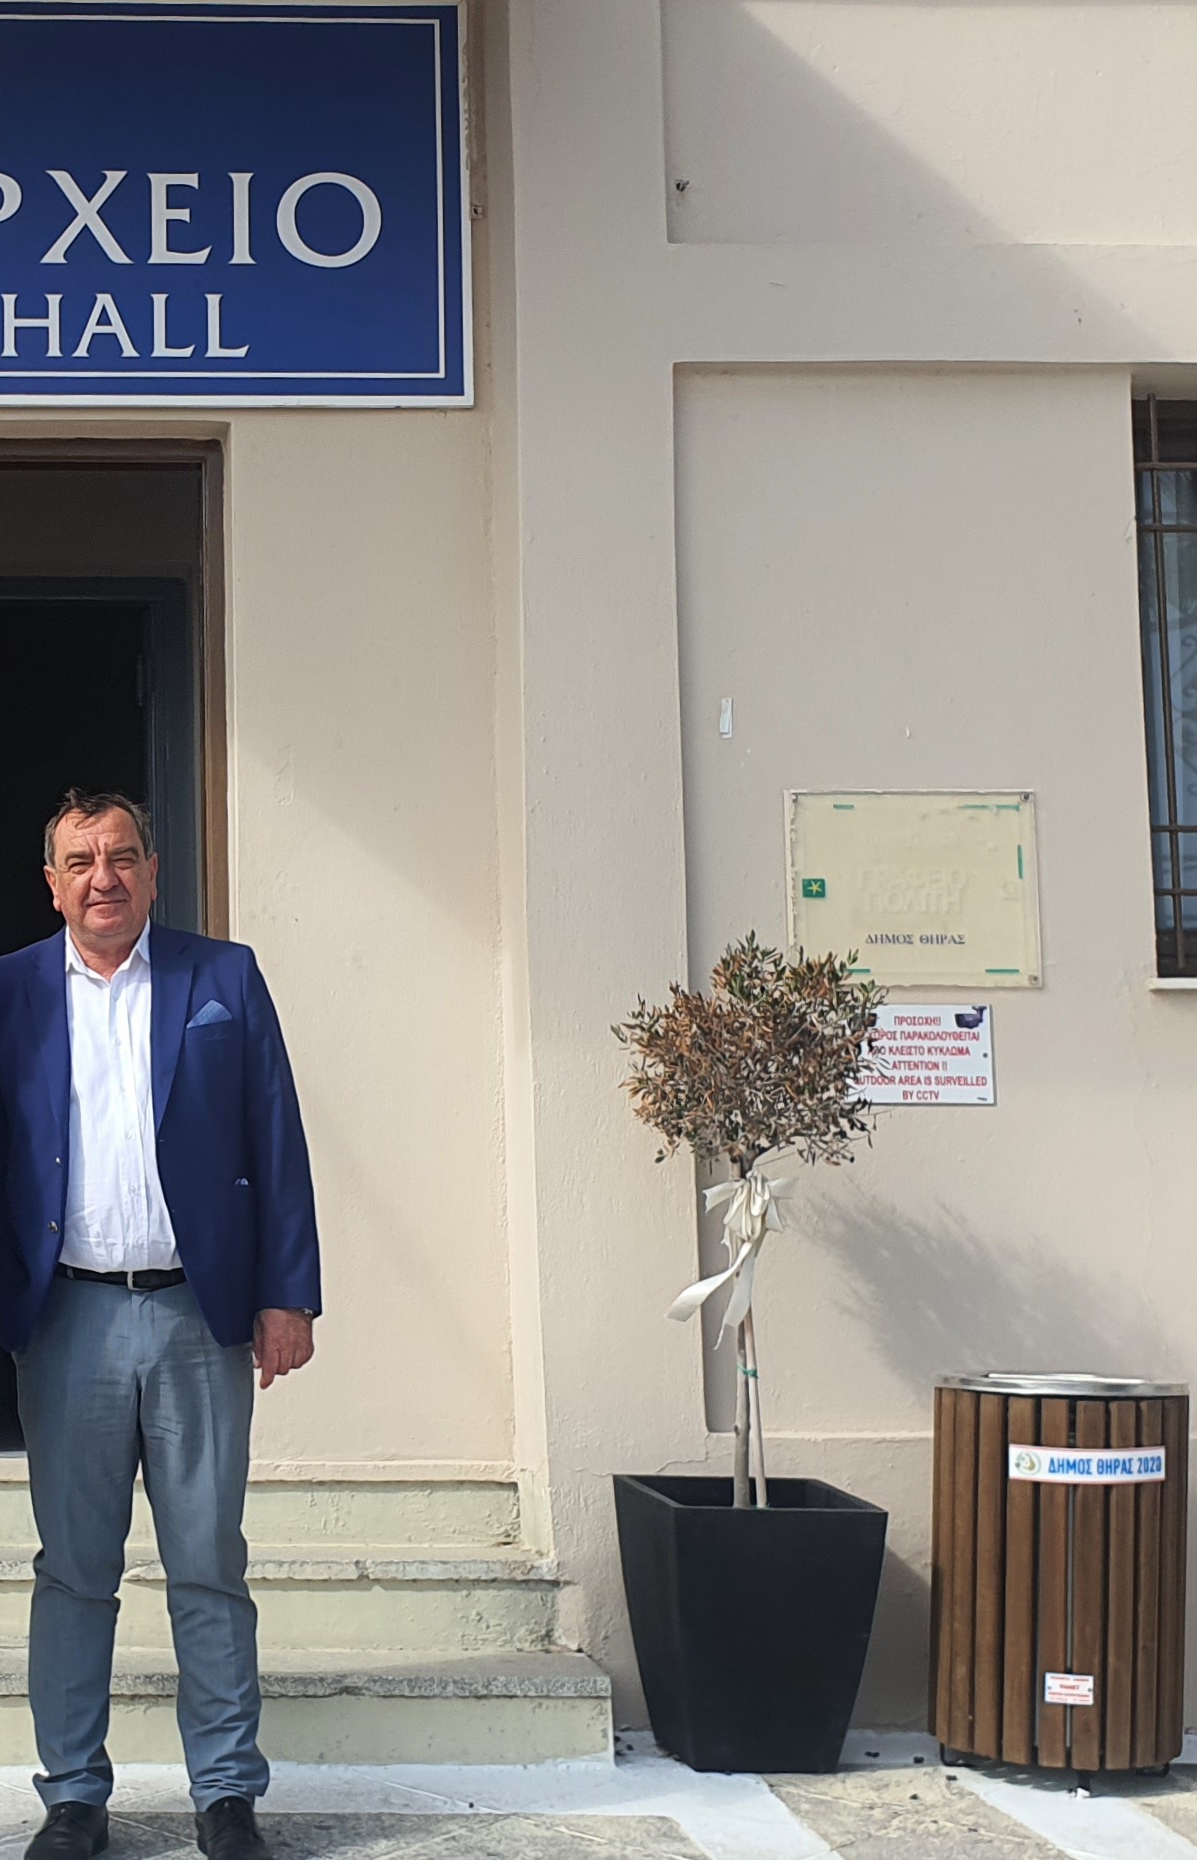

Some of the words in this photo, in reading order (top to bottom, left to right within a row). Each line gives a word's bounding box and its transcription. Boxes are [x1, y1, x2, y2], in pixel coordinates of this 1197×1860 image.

[2, 293, 249, 360] HALL
[865, 933, 914, 945] ΔΗΜΟΣ
[919, 934, 966, 945] ΘΗΡΑΣ
[888, 1046, 925, 1056] ΚΛΕΙΣΤΟ
[927, 1046, 971, 1056] ΚΥΚΛΩΜΑ
[892, 1061, 940, 1071] ATTENTION
[898, 1076, 922, 1086] AREA
[924, 1076, 932, 1086] IS
[935, 1076, 988, 1087] SURVEILLED
[902, 1090, 914, 1101] BY
[916, 1090, 940, 1101] CCTV
[1048, 1457, 1093, 1475] ΔΗΜΟΣ
[1097, 1457, 1134, 1475] ΘΗΡΑΣ
